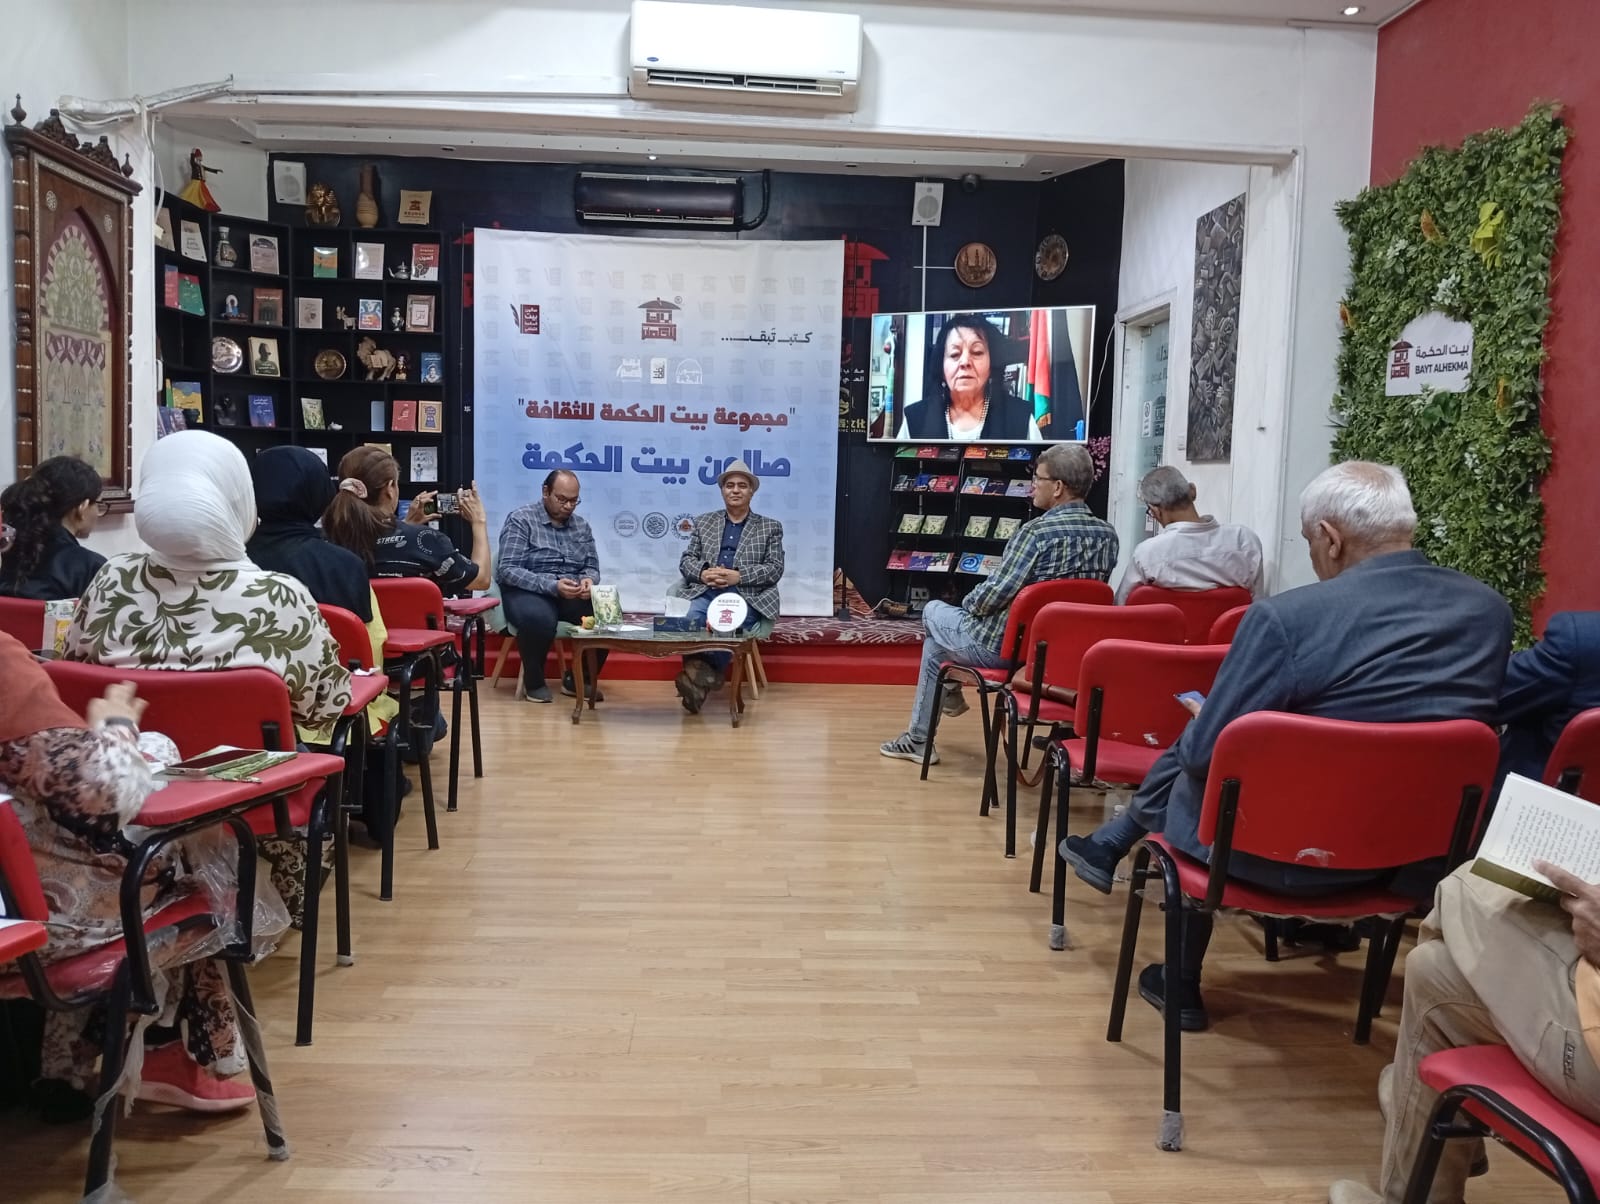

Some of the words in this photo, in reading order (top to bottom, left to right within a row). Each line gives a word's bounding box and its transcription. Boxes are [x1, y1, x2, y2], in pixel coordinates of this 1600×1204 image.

[1415, 344, 1448, 359] الحكمة
[1449, 344, 1470, 356] بيت
[1415, 364, 1433, 374] BAYT
[1433, 361, 1469, 373] ALHEKMA
[600, 402, 665, 423] الحكمة
[670, 406, 708, 431] بيت
[522, 442, 623, 472] الحكمة
[631, 446, 690, 485] بيت
[376, 535, 406, 544] STREET
